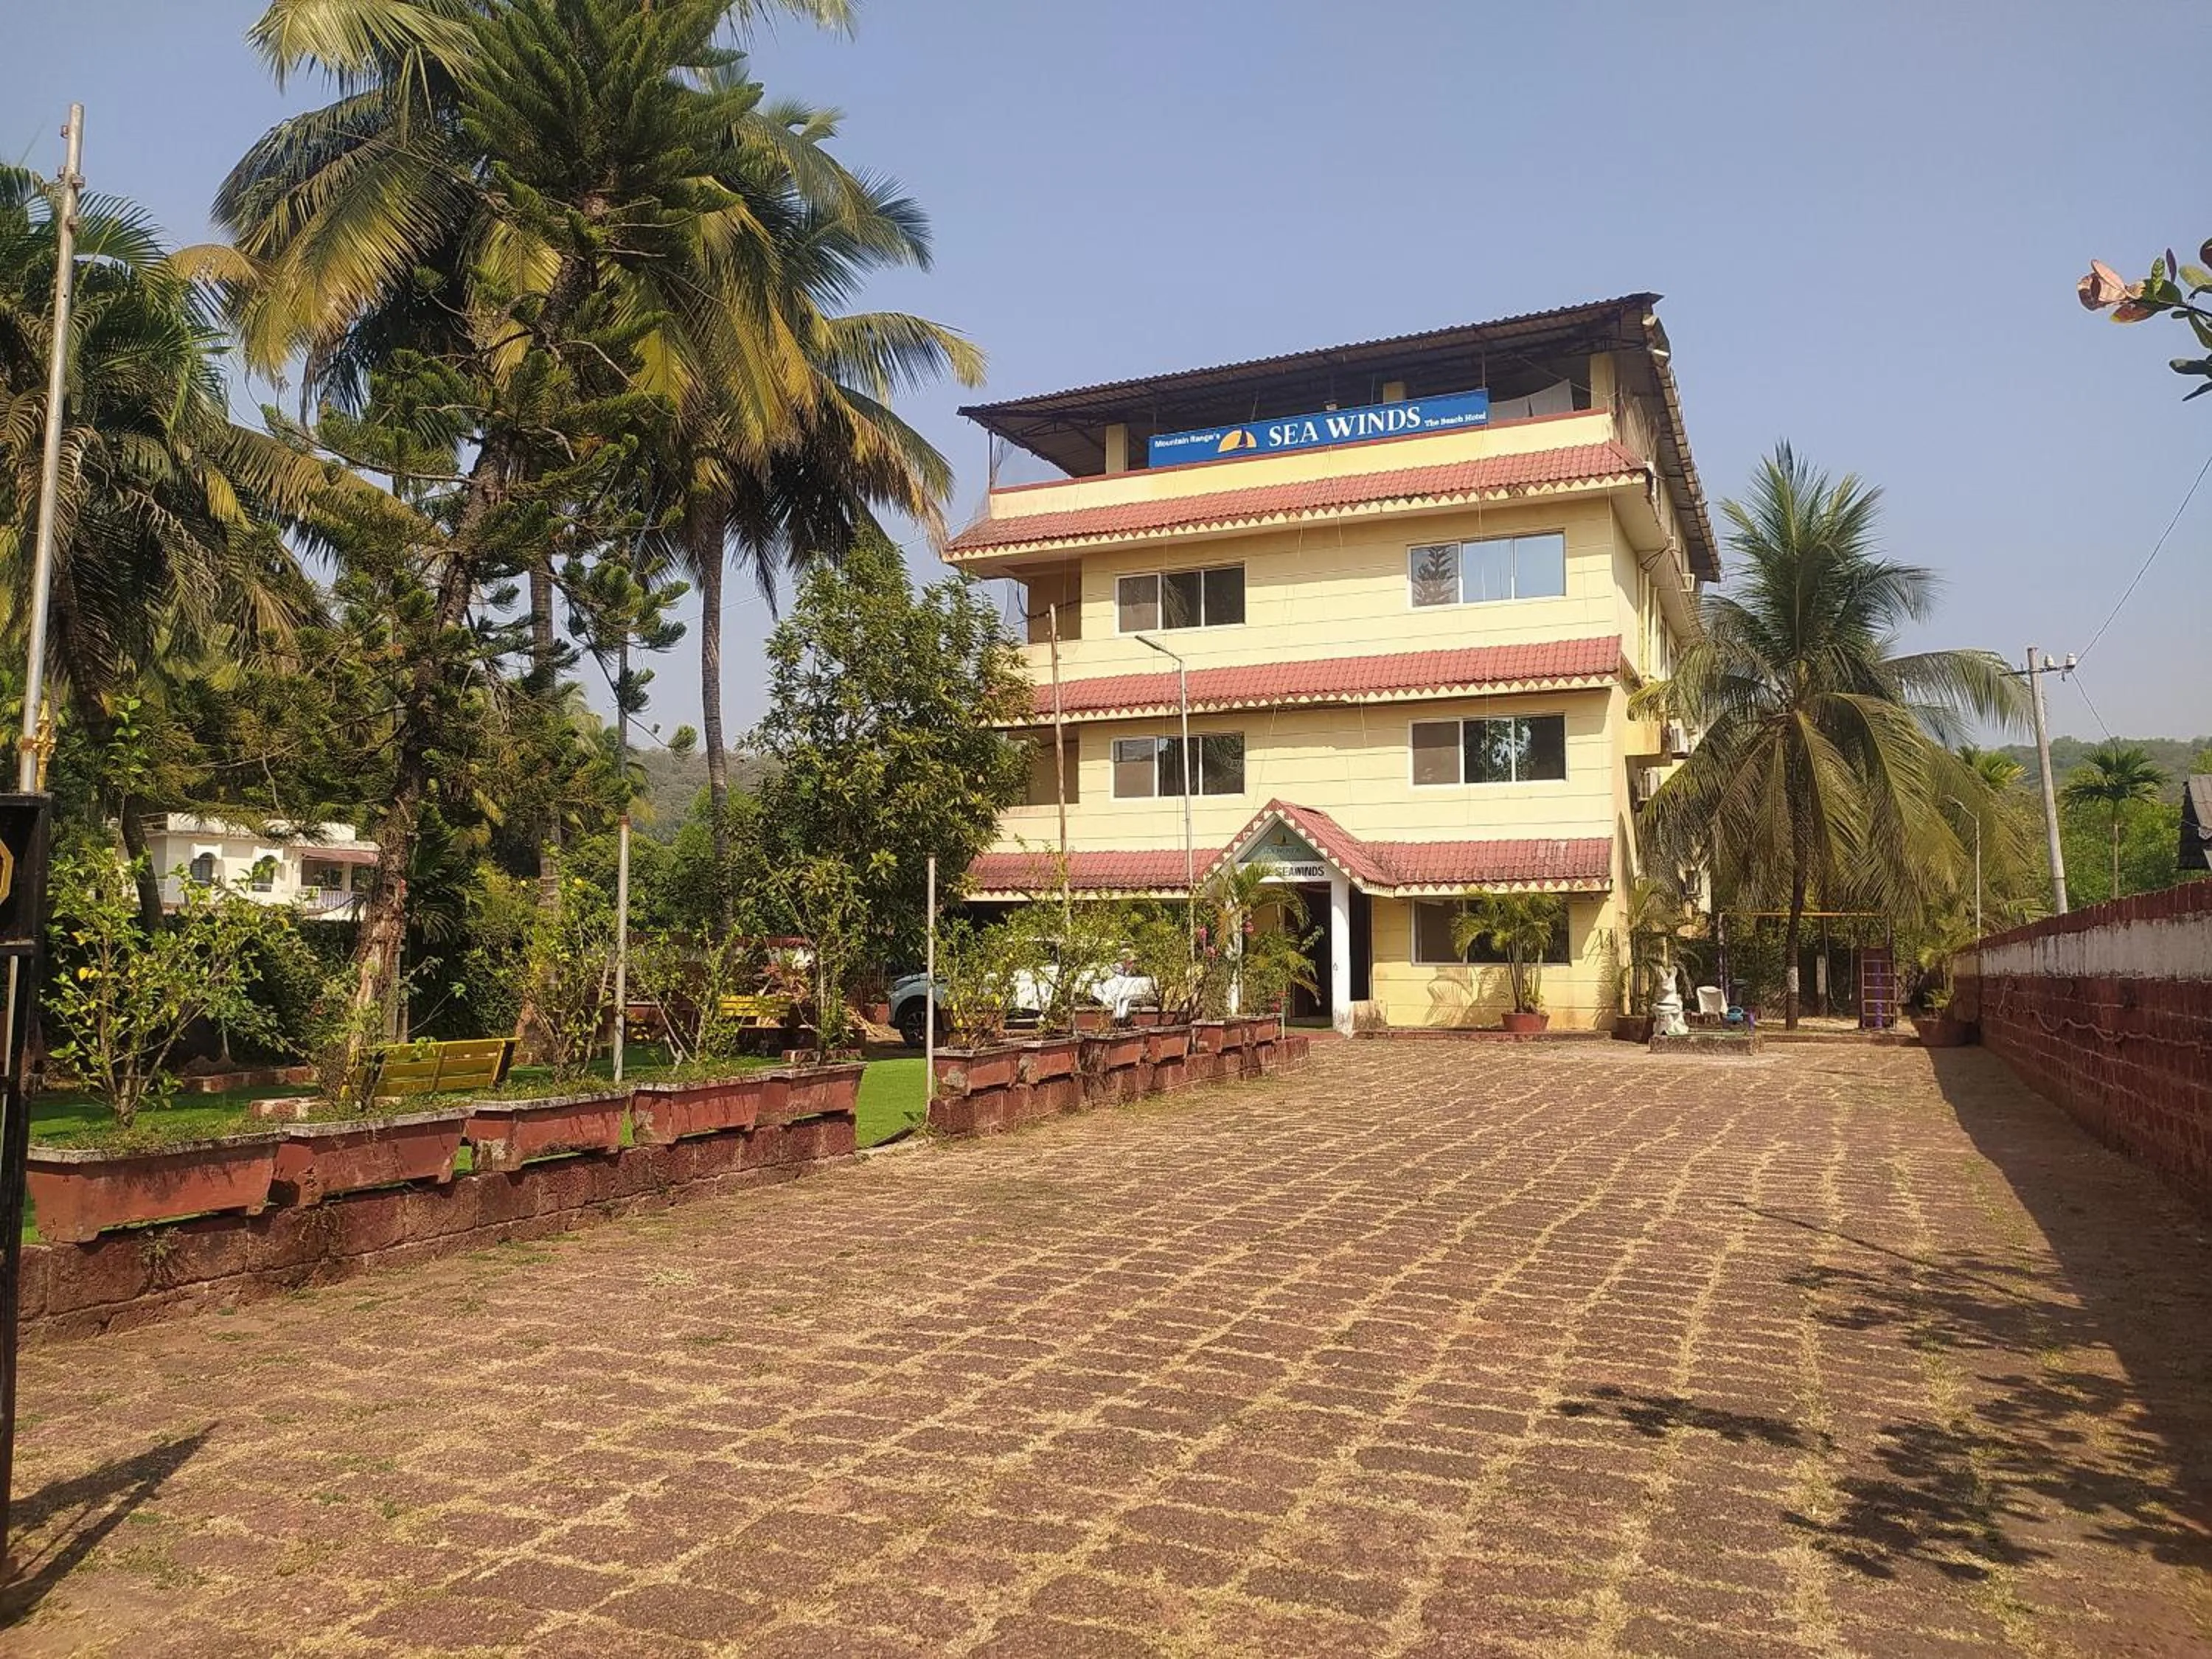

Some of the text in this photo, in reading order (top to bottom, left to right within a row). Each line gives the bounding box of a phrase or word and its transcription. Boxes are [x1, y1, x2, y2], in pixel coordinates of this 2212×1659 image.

[1269, 406, 1422, 447] SEA WINDS
[1424, 410, 1486, 427] The Beach Hotel
[1155, 433, 1220, 448] Mountain Range's
